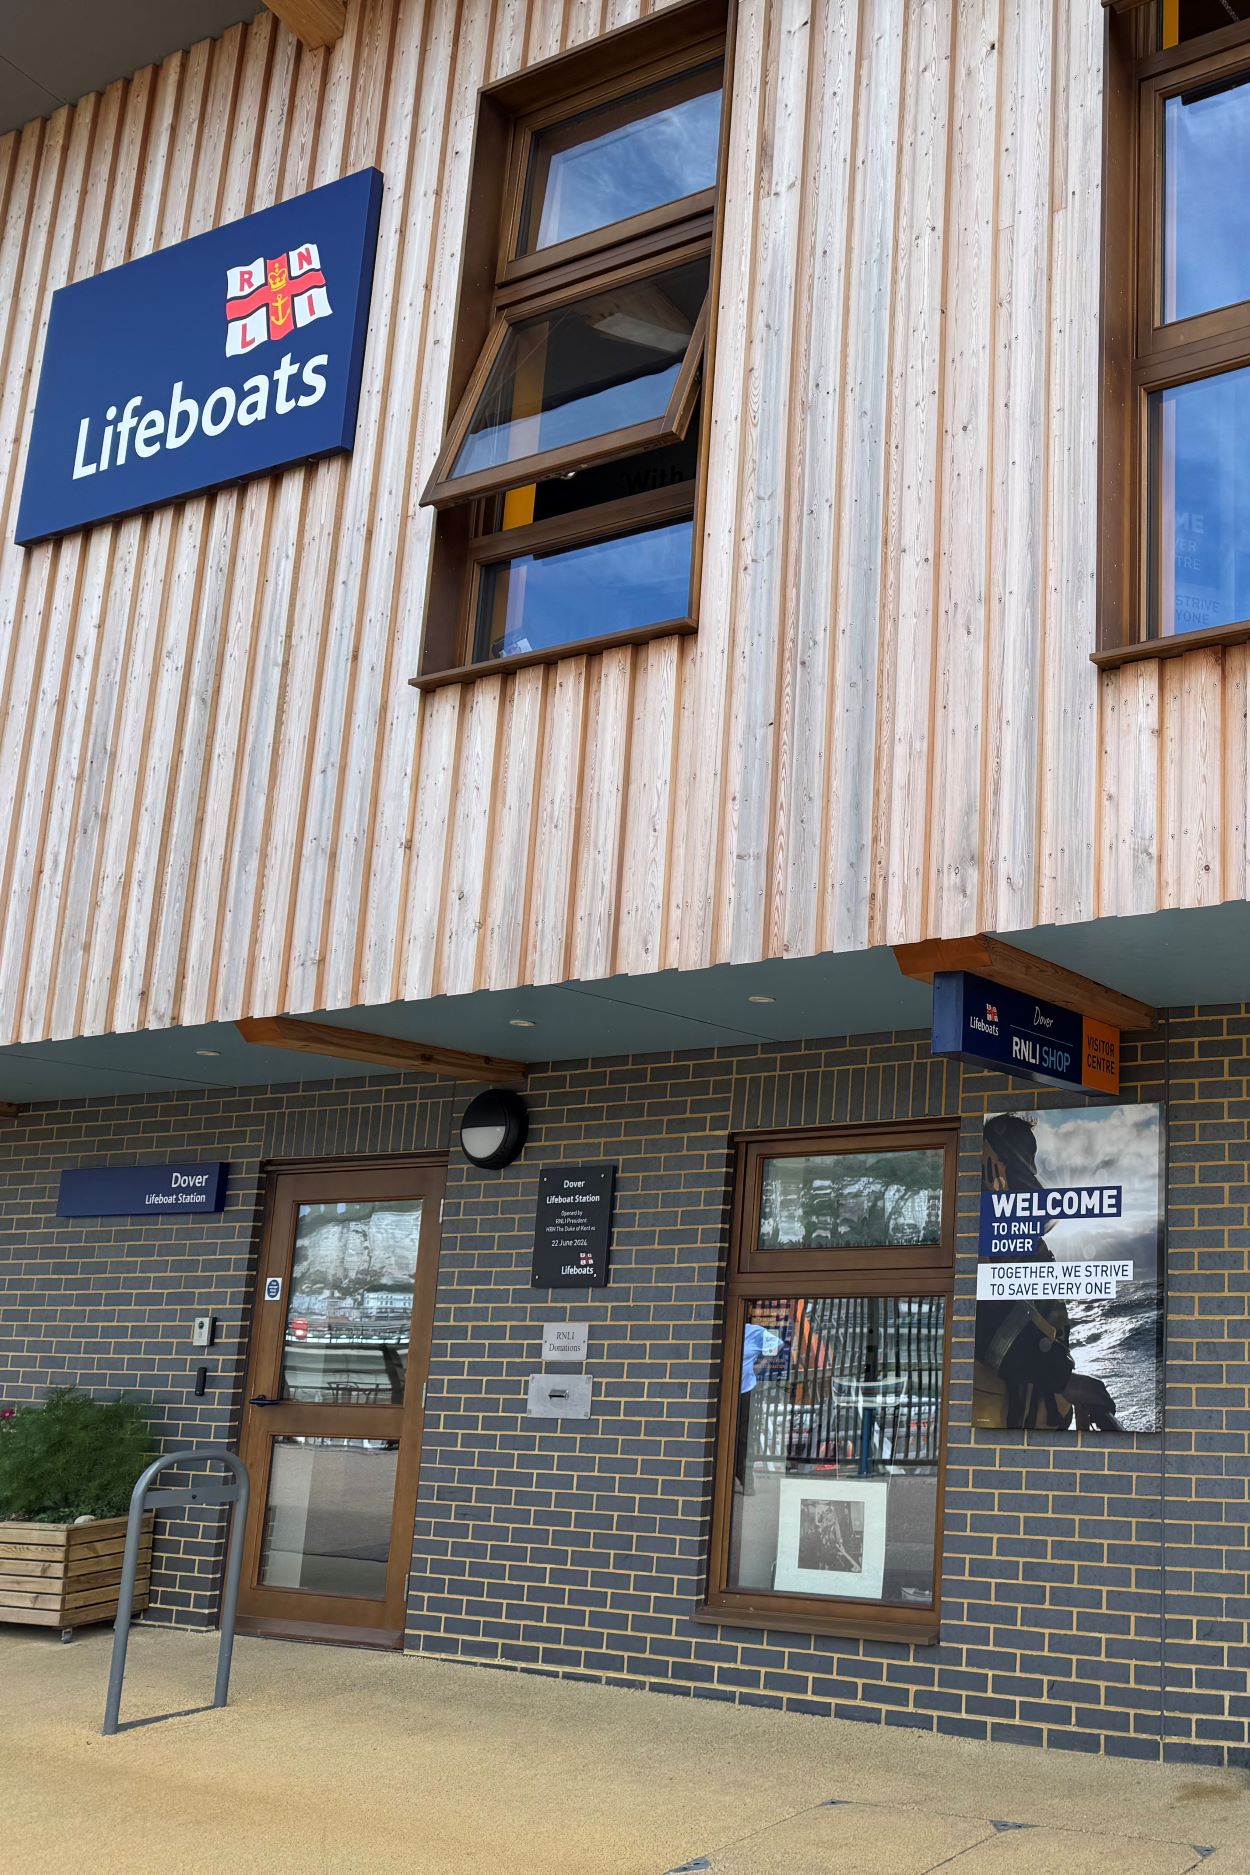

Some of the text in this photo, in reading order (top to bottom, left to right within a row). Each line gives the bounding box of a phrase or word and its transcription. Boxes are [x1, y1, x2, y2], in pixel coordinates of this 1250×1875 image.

[72, 352, 329, 480] Lifeboats
[1033, 1006, 1054, 1028] Dover
[970, 1016, 999, 1036] Lifeboats
[1087, 1034, 1115, 1058] VISITOR
[1012, 1036, 1071, 1073] RNLI SHOP
[1087, 1054, 1115, 1075] CENTRE
[171, 1172, 209, 1188] Dover
[563, 1180, 586, 1188] Dover
[145, 1192, 206, 1204] Lifeboat Station
[546, 1194, 600, 1204] Lifeboat Station
[991, 1189, 1118, 1218] WELCOME
[991, 1221, 1041, 1236] TO RNLI
[551, 1239, 558, 1247] 22
[991, 1239, 1033, 1253] DOVER
[561, 1265, 594, 1275] Lifeboats
[990, 1264, 1129, 1280] TOGETHER, WE STRIVE
[990, 1281, 1112, 1296] TO SAVE EVERY ONE
[556, 1331, 575, 1340] RNLI
[549, 1343, 581, 1352] Donations
